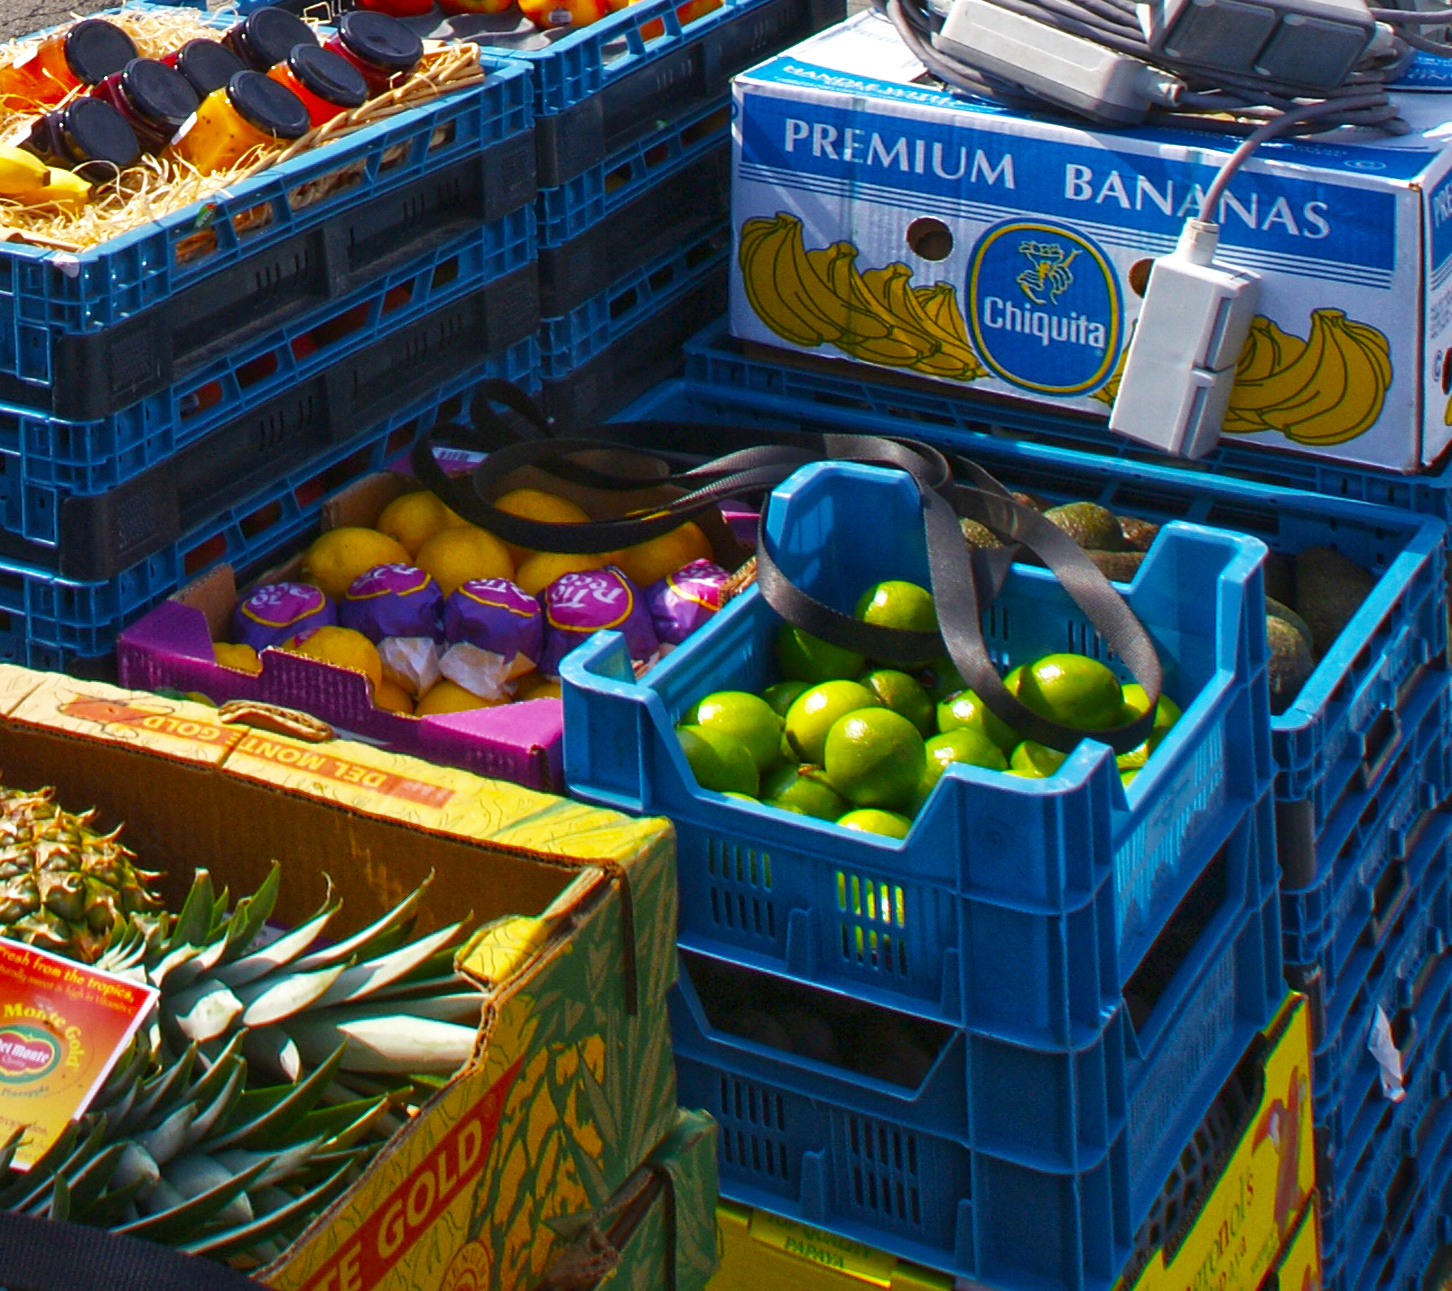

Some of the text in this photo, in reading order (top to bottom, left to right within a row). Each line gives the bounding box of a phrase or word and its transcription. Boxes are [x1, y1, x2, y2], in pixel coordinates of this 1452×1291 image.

[783, 118, 1332, 240] PREMIUM BANANAS
[983, 296, 1106, 347] Chiquita
[142, 715, 222, 742] GOLD
[335, 760, 387, 789] DEL
[32, 955, 62, 978] from
[63, 969, 86, 986] the
[87, 976, 135, 1003] tropics,
[3, 1002, 67, 1030] Monte
[64, 1023, 86, 1070] Gold
[11, 1041, 51, 1065] Monte
[377, 1120, 483, 1259] GOLD
